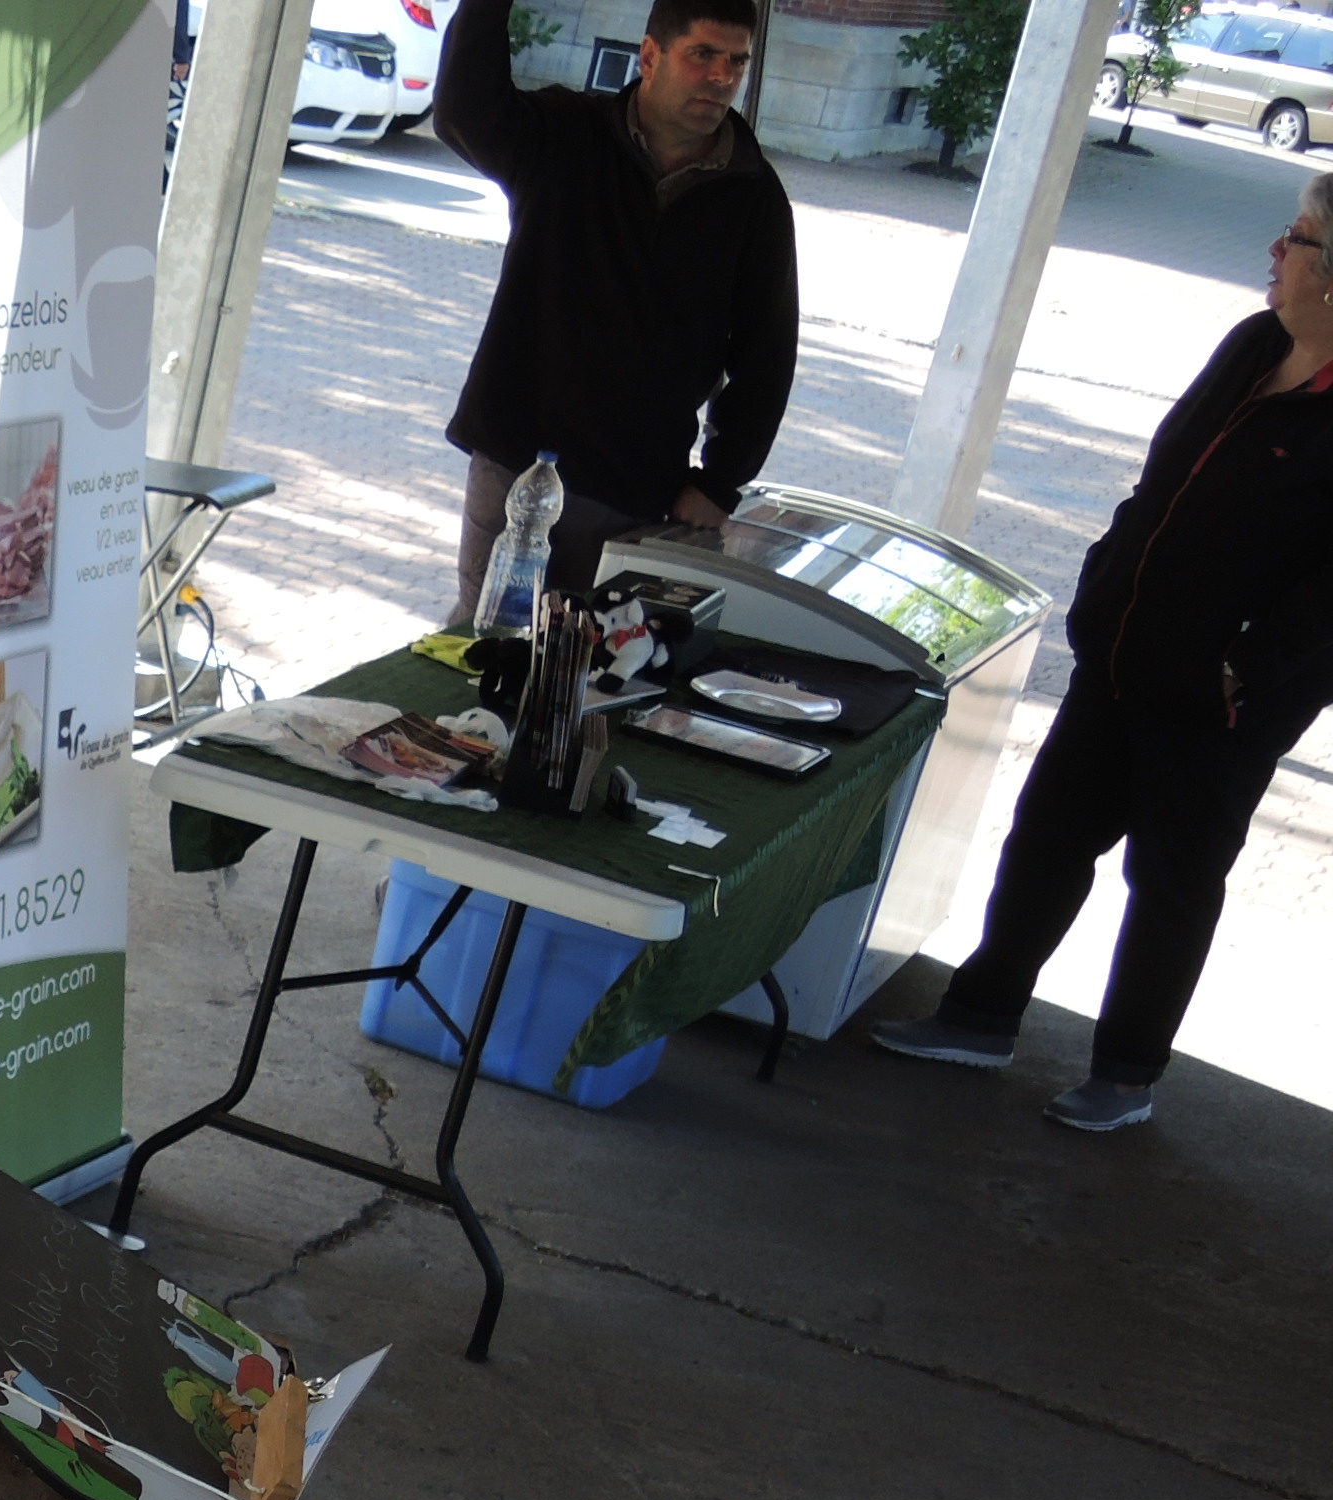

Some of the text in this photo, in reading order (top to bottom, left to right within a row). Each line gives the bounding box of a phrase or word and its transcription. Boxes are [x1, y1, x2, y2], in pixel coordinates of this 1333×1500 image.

[67, 468, 139, 497] veau de grain
[100, 498, 139, 520] en vrac
[96, 528, 137, 552] 1/2 veau
[76, 554, 136, 583] veau entier
[80, 739, 100, 756] Veau
